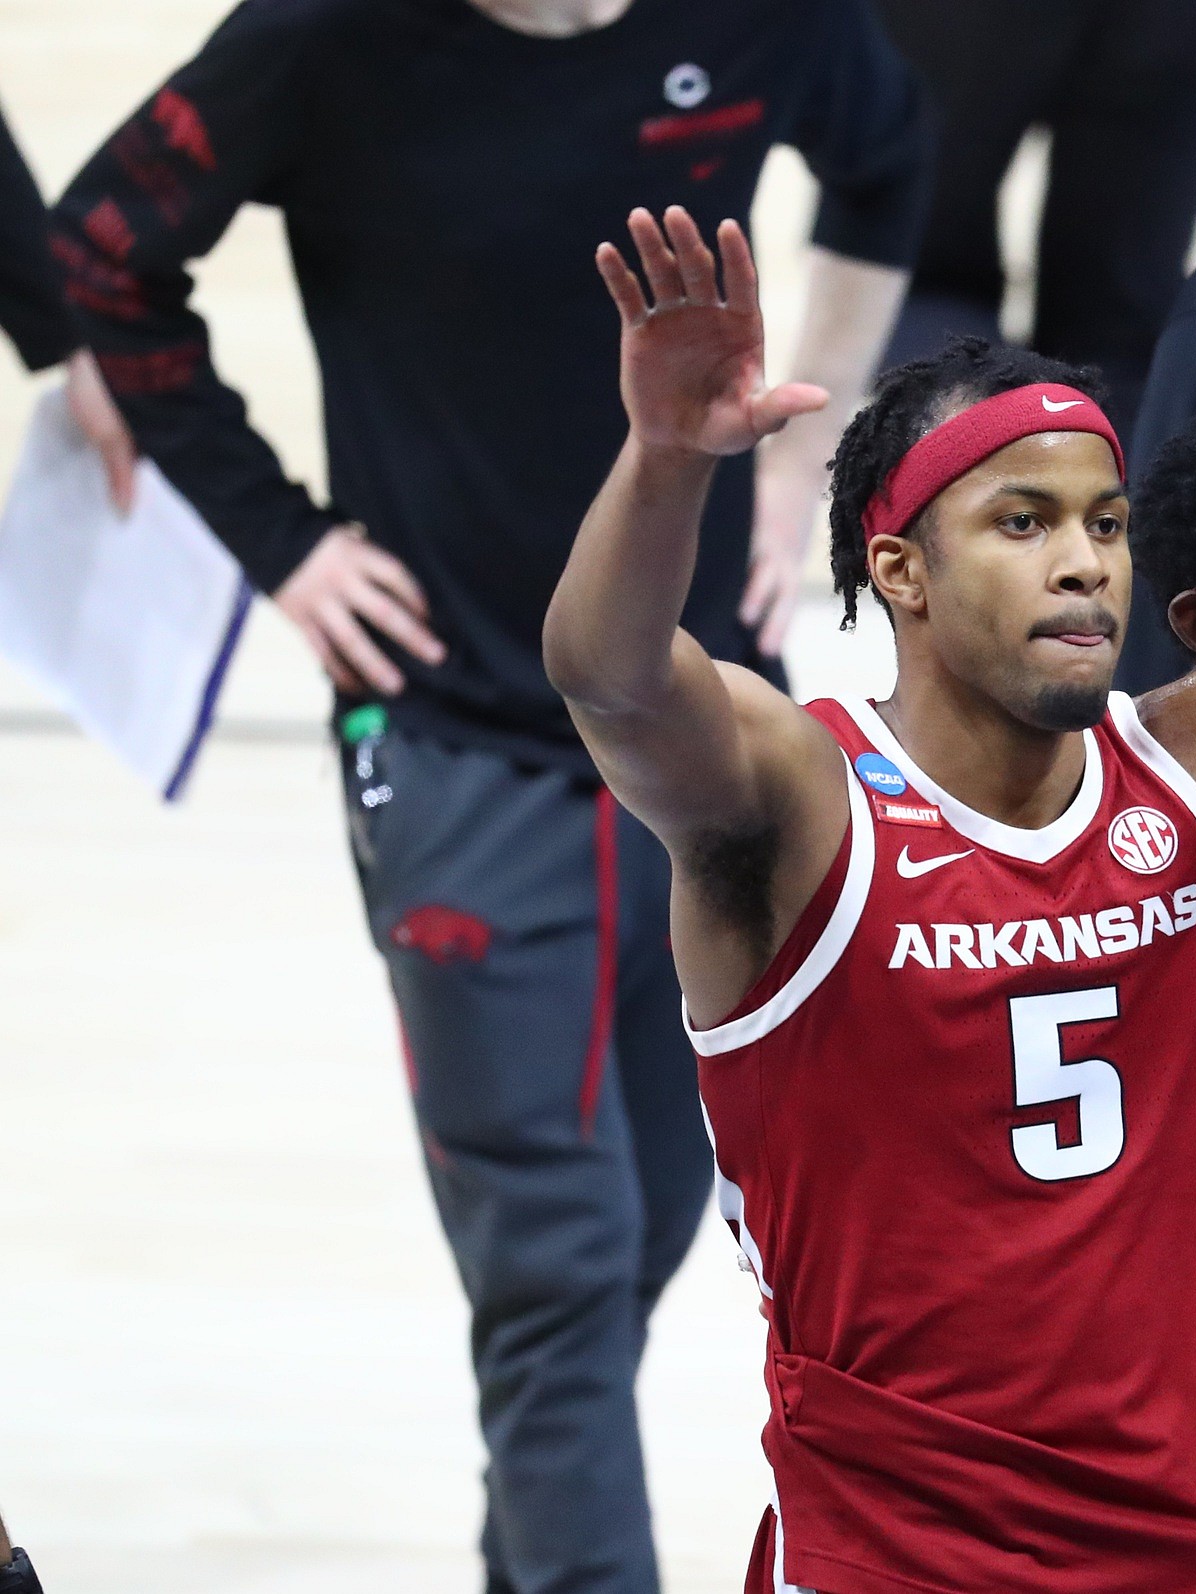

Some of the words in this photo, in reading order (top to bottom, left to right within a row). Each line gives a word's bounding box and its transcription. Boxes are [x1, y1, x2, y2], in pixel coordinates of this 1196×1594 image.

[865, 771, 904, 786] NCAA
[886, 805, 938, 822] EQUALITY
[1112, 810, 1174, 870] SEC
[1009, 986, 1124, 1182] 5
